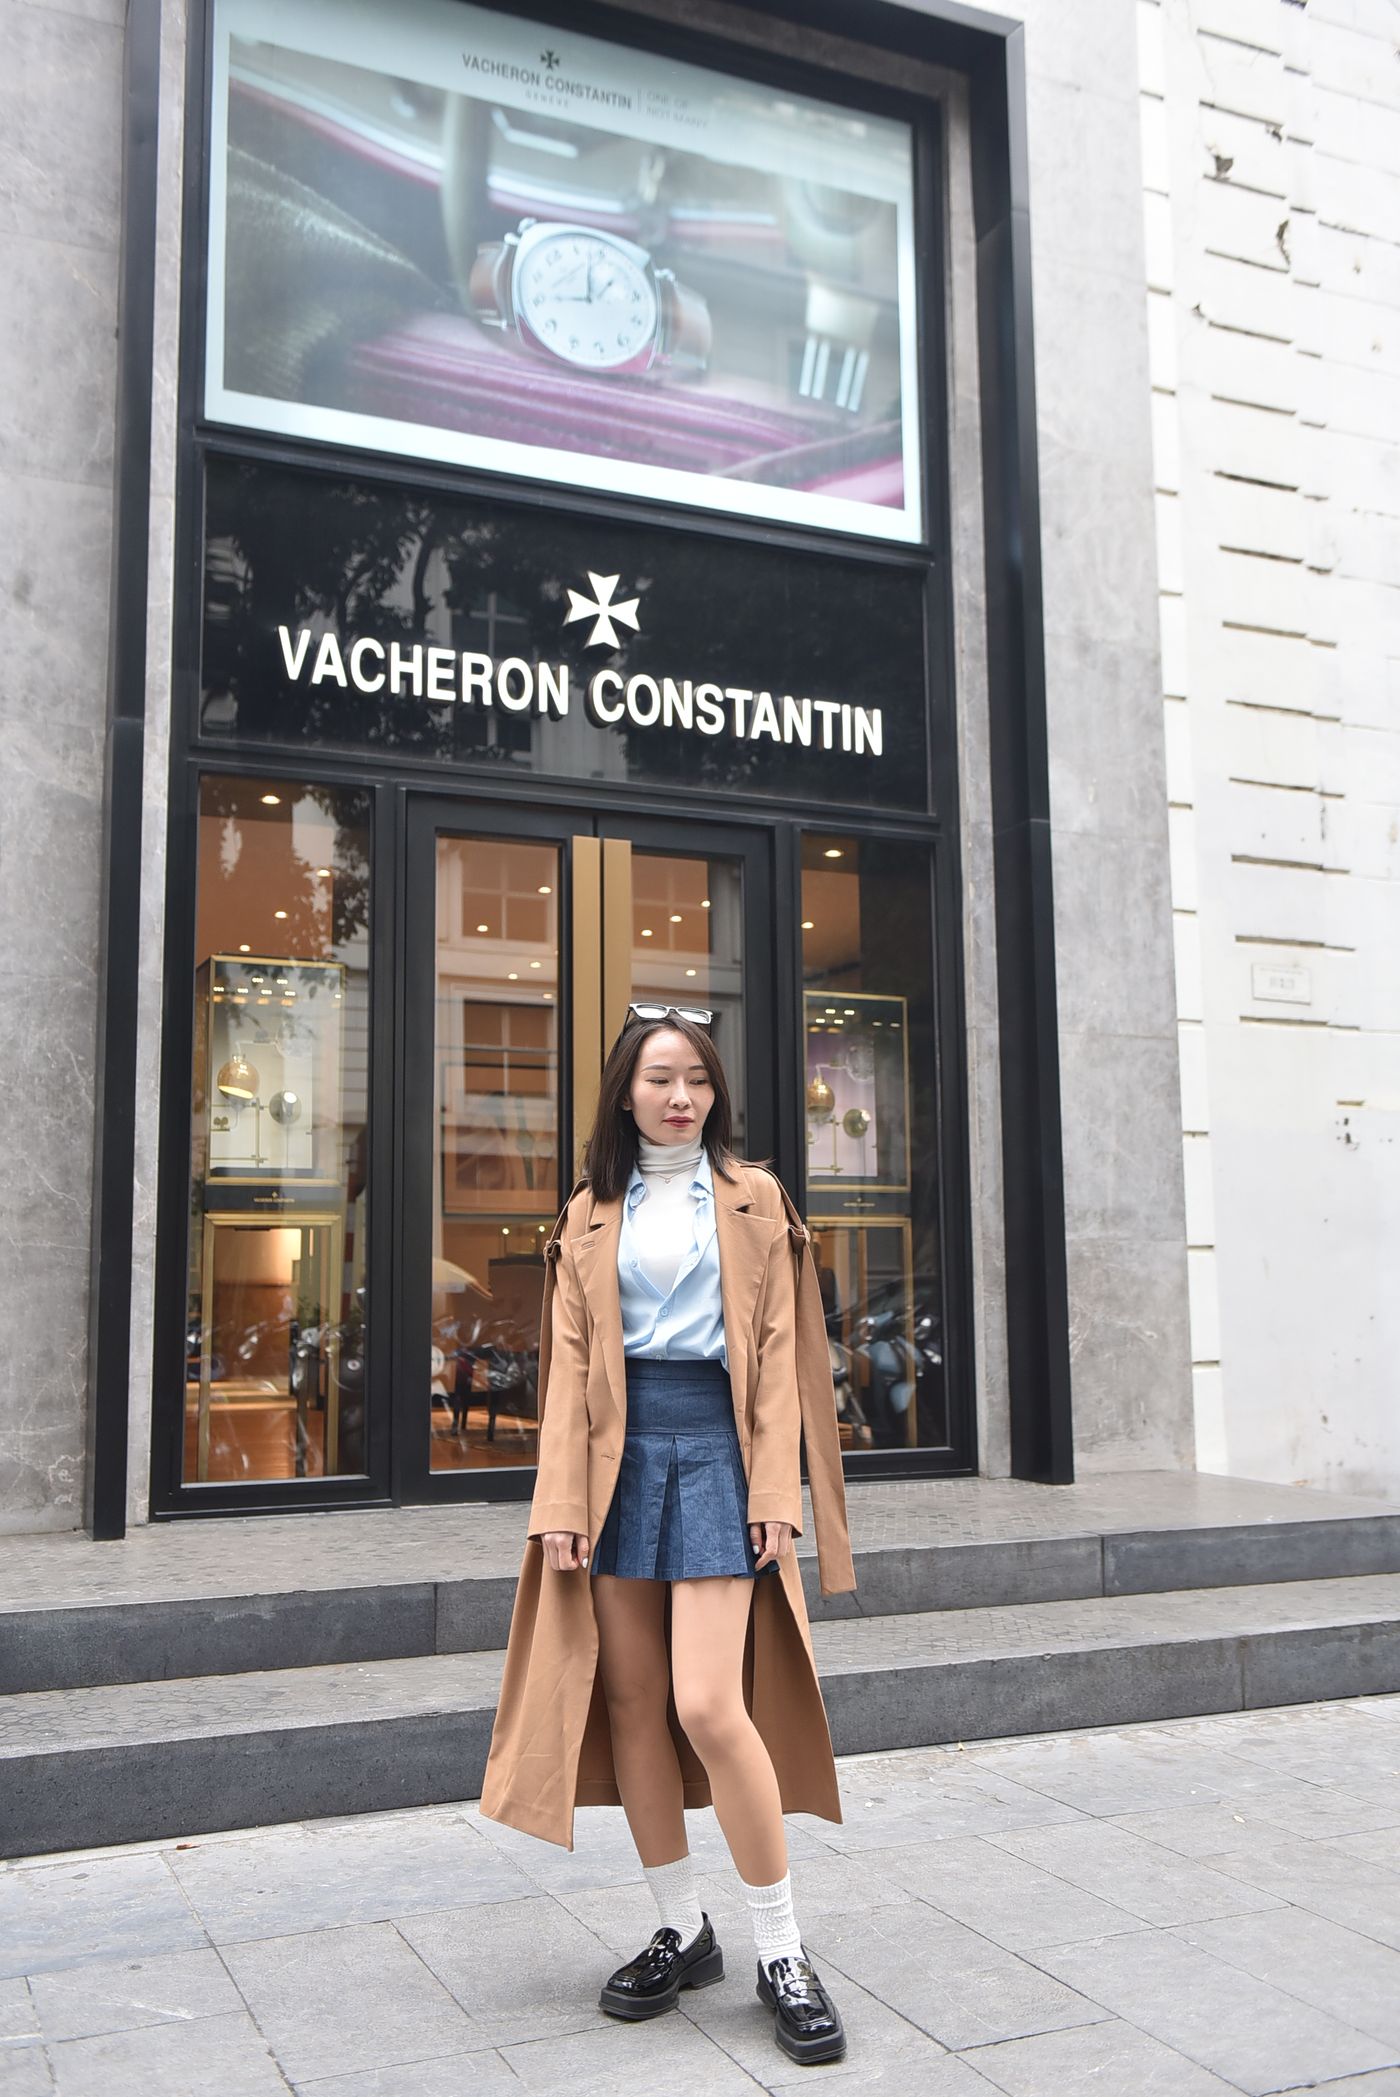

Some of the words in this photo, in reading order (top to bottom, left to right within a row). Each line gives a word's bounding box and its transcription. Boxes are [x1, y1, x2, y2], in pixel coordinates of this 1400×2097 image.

[462, 54, 541, 87] VACHERON
[545, 75, 632, 110] CONSTANTIN
[278, 625, 570, 716] VACHERON
[591, 669, 883, 756] CONSTANTIN
